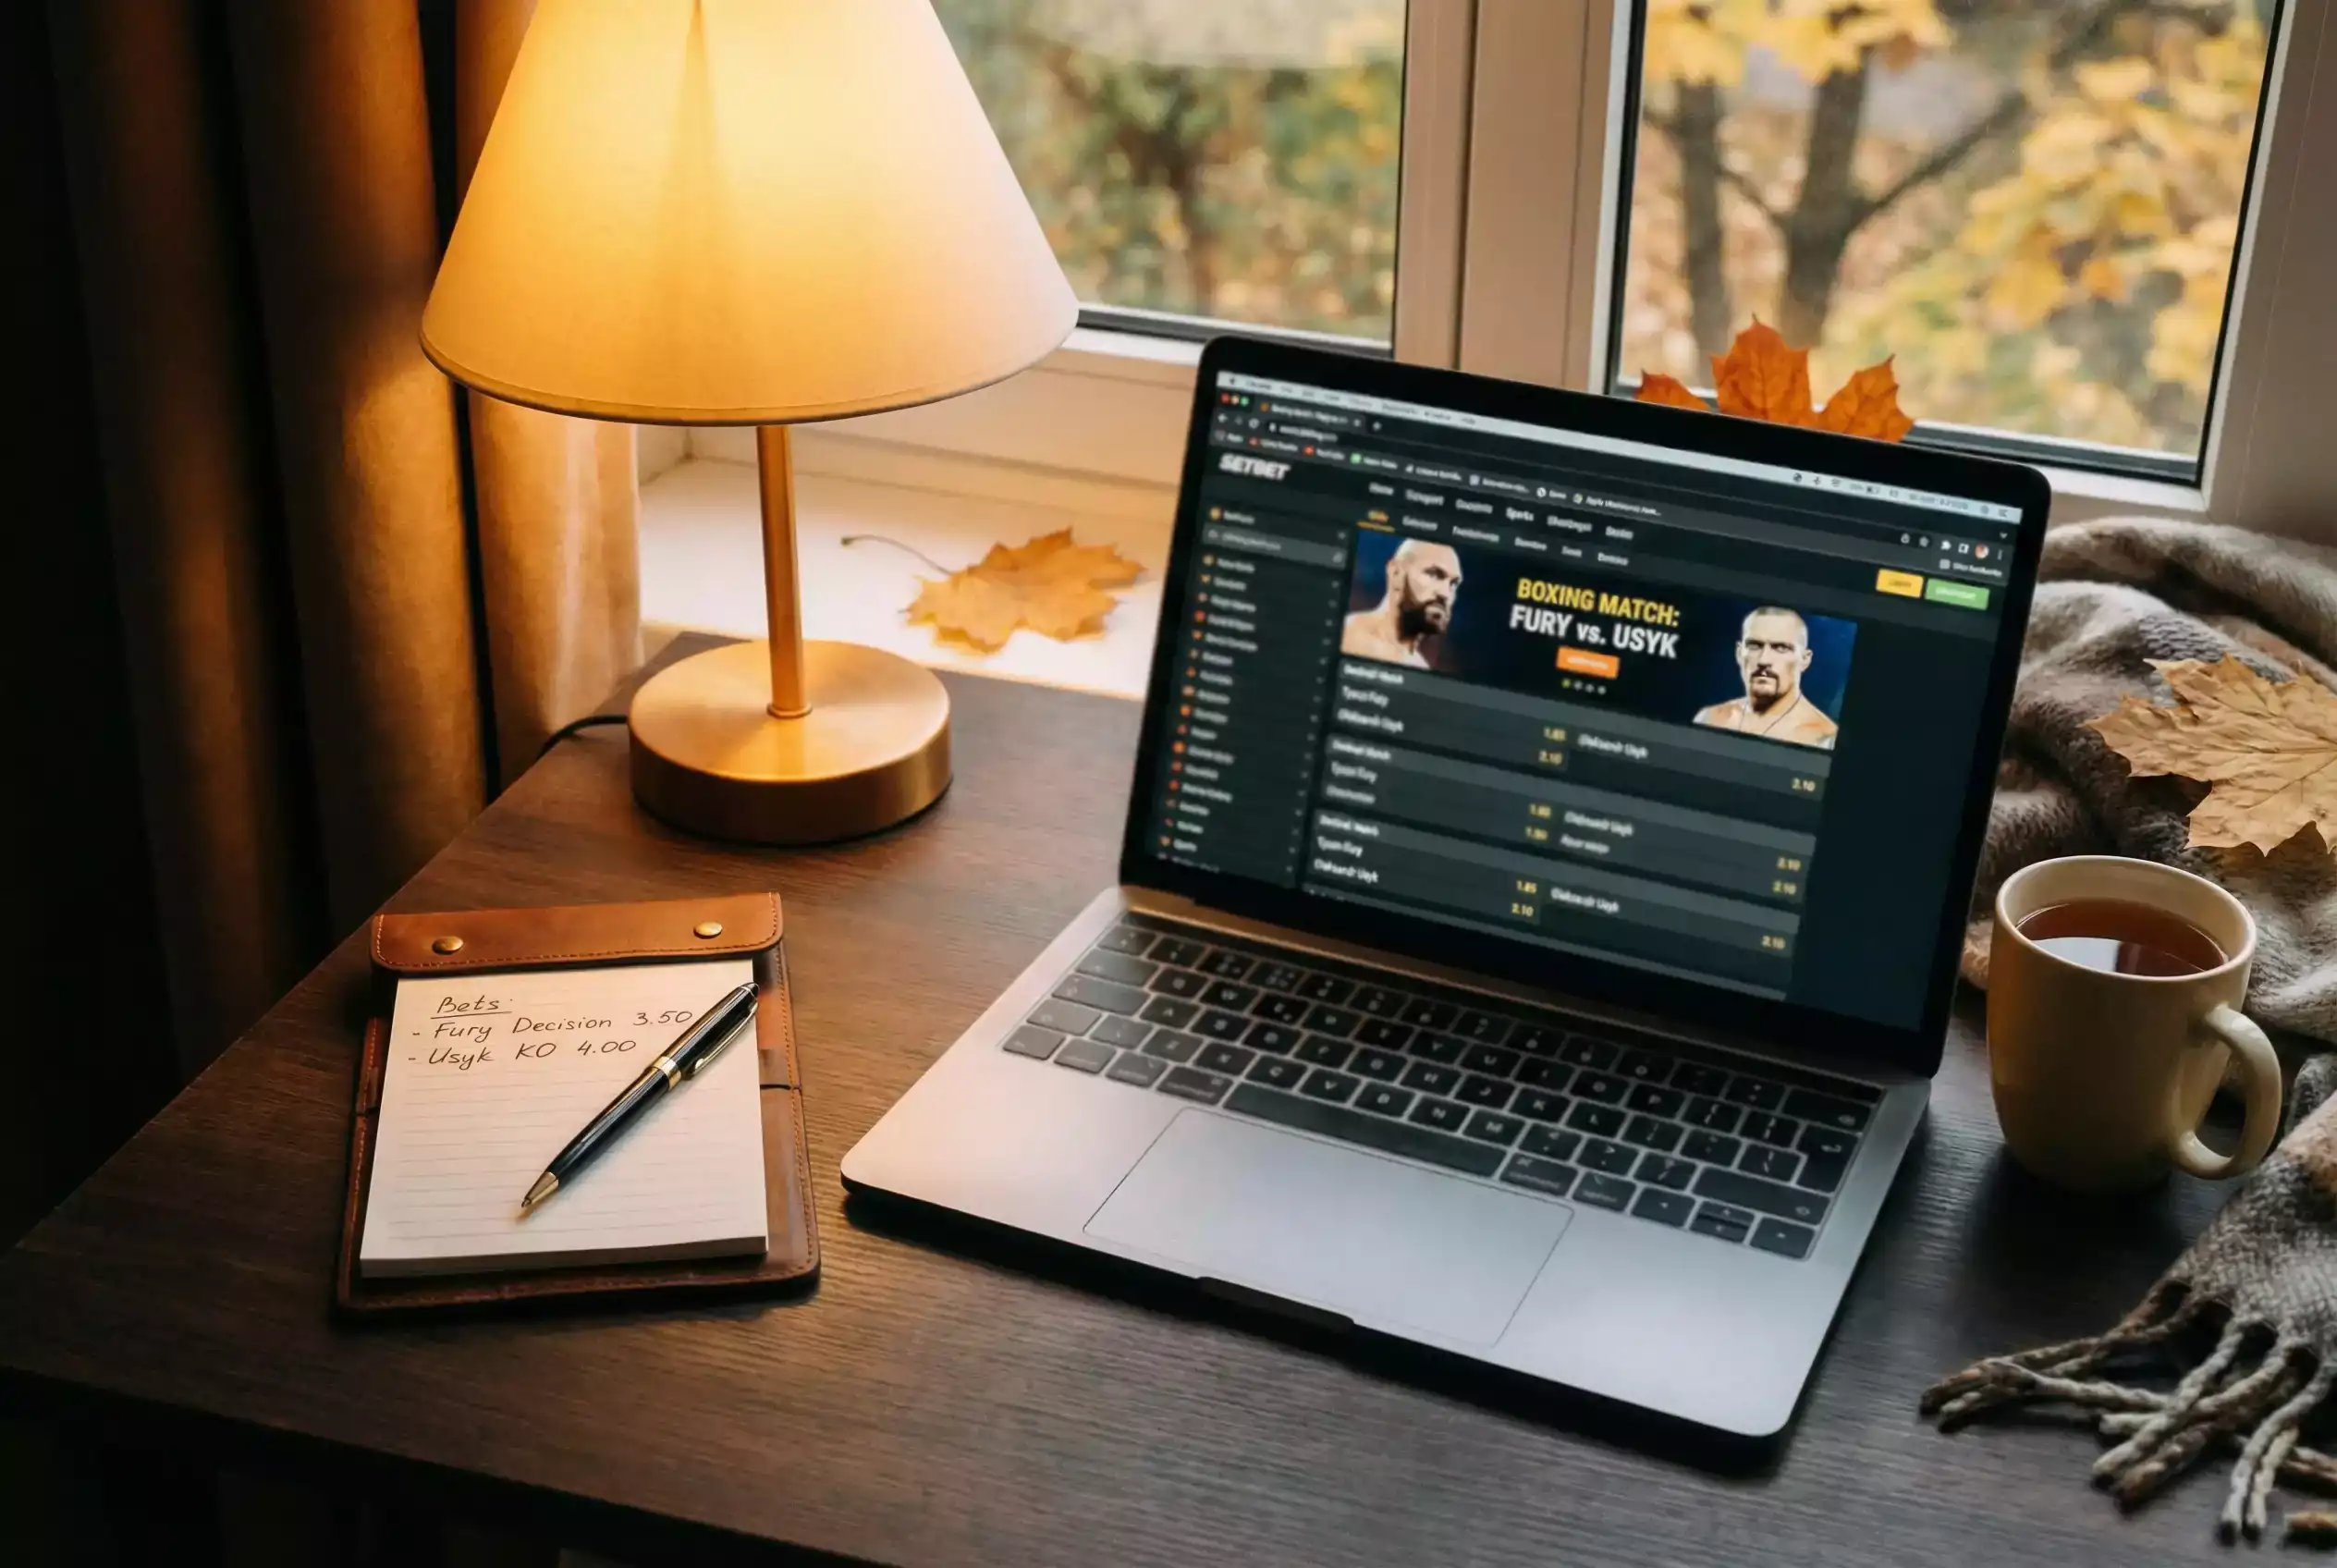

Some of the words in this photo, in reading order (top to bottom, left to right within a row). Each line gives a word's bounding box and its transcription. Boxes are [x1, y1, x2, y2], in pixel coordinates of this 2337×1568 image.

[1517, 578, 1595, 611] BOXING
[1597, 593, 1681, 627] MATCH:
[1509, 604, 1572, 638] FURY
[1576, 622, 1607, 645] vs.
[1612, 623, 1679, 658] USYK
[1511, 902, 1535, 917] 2.10
[434, 1022, 493, 1043] Fury
[511, 1016, 612, 1034] Decision
[632, 1011, 693, 1026] 3.50
[428, 1047, 495, 1071] Usyk
[515, 1042, 557, 1060] KO
[577, 1040, 637, 1057] 4.00
